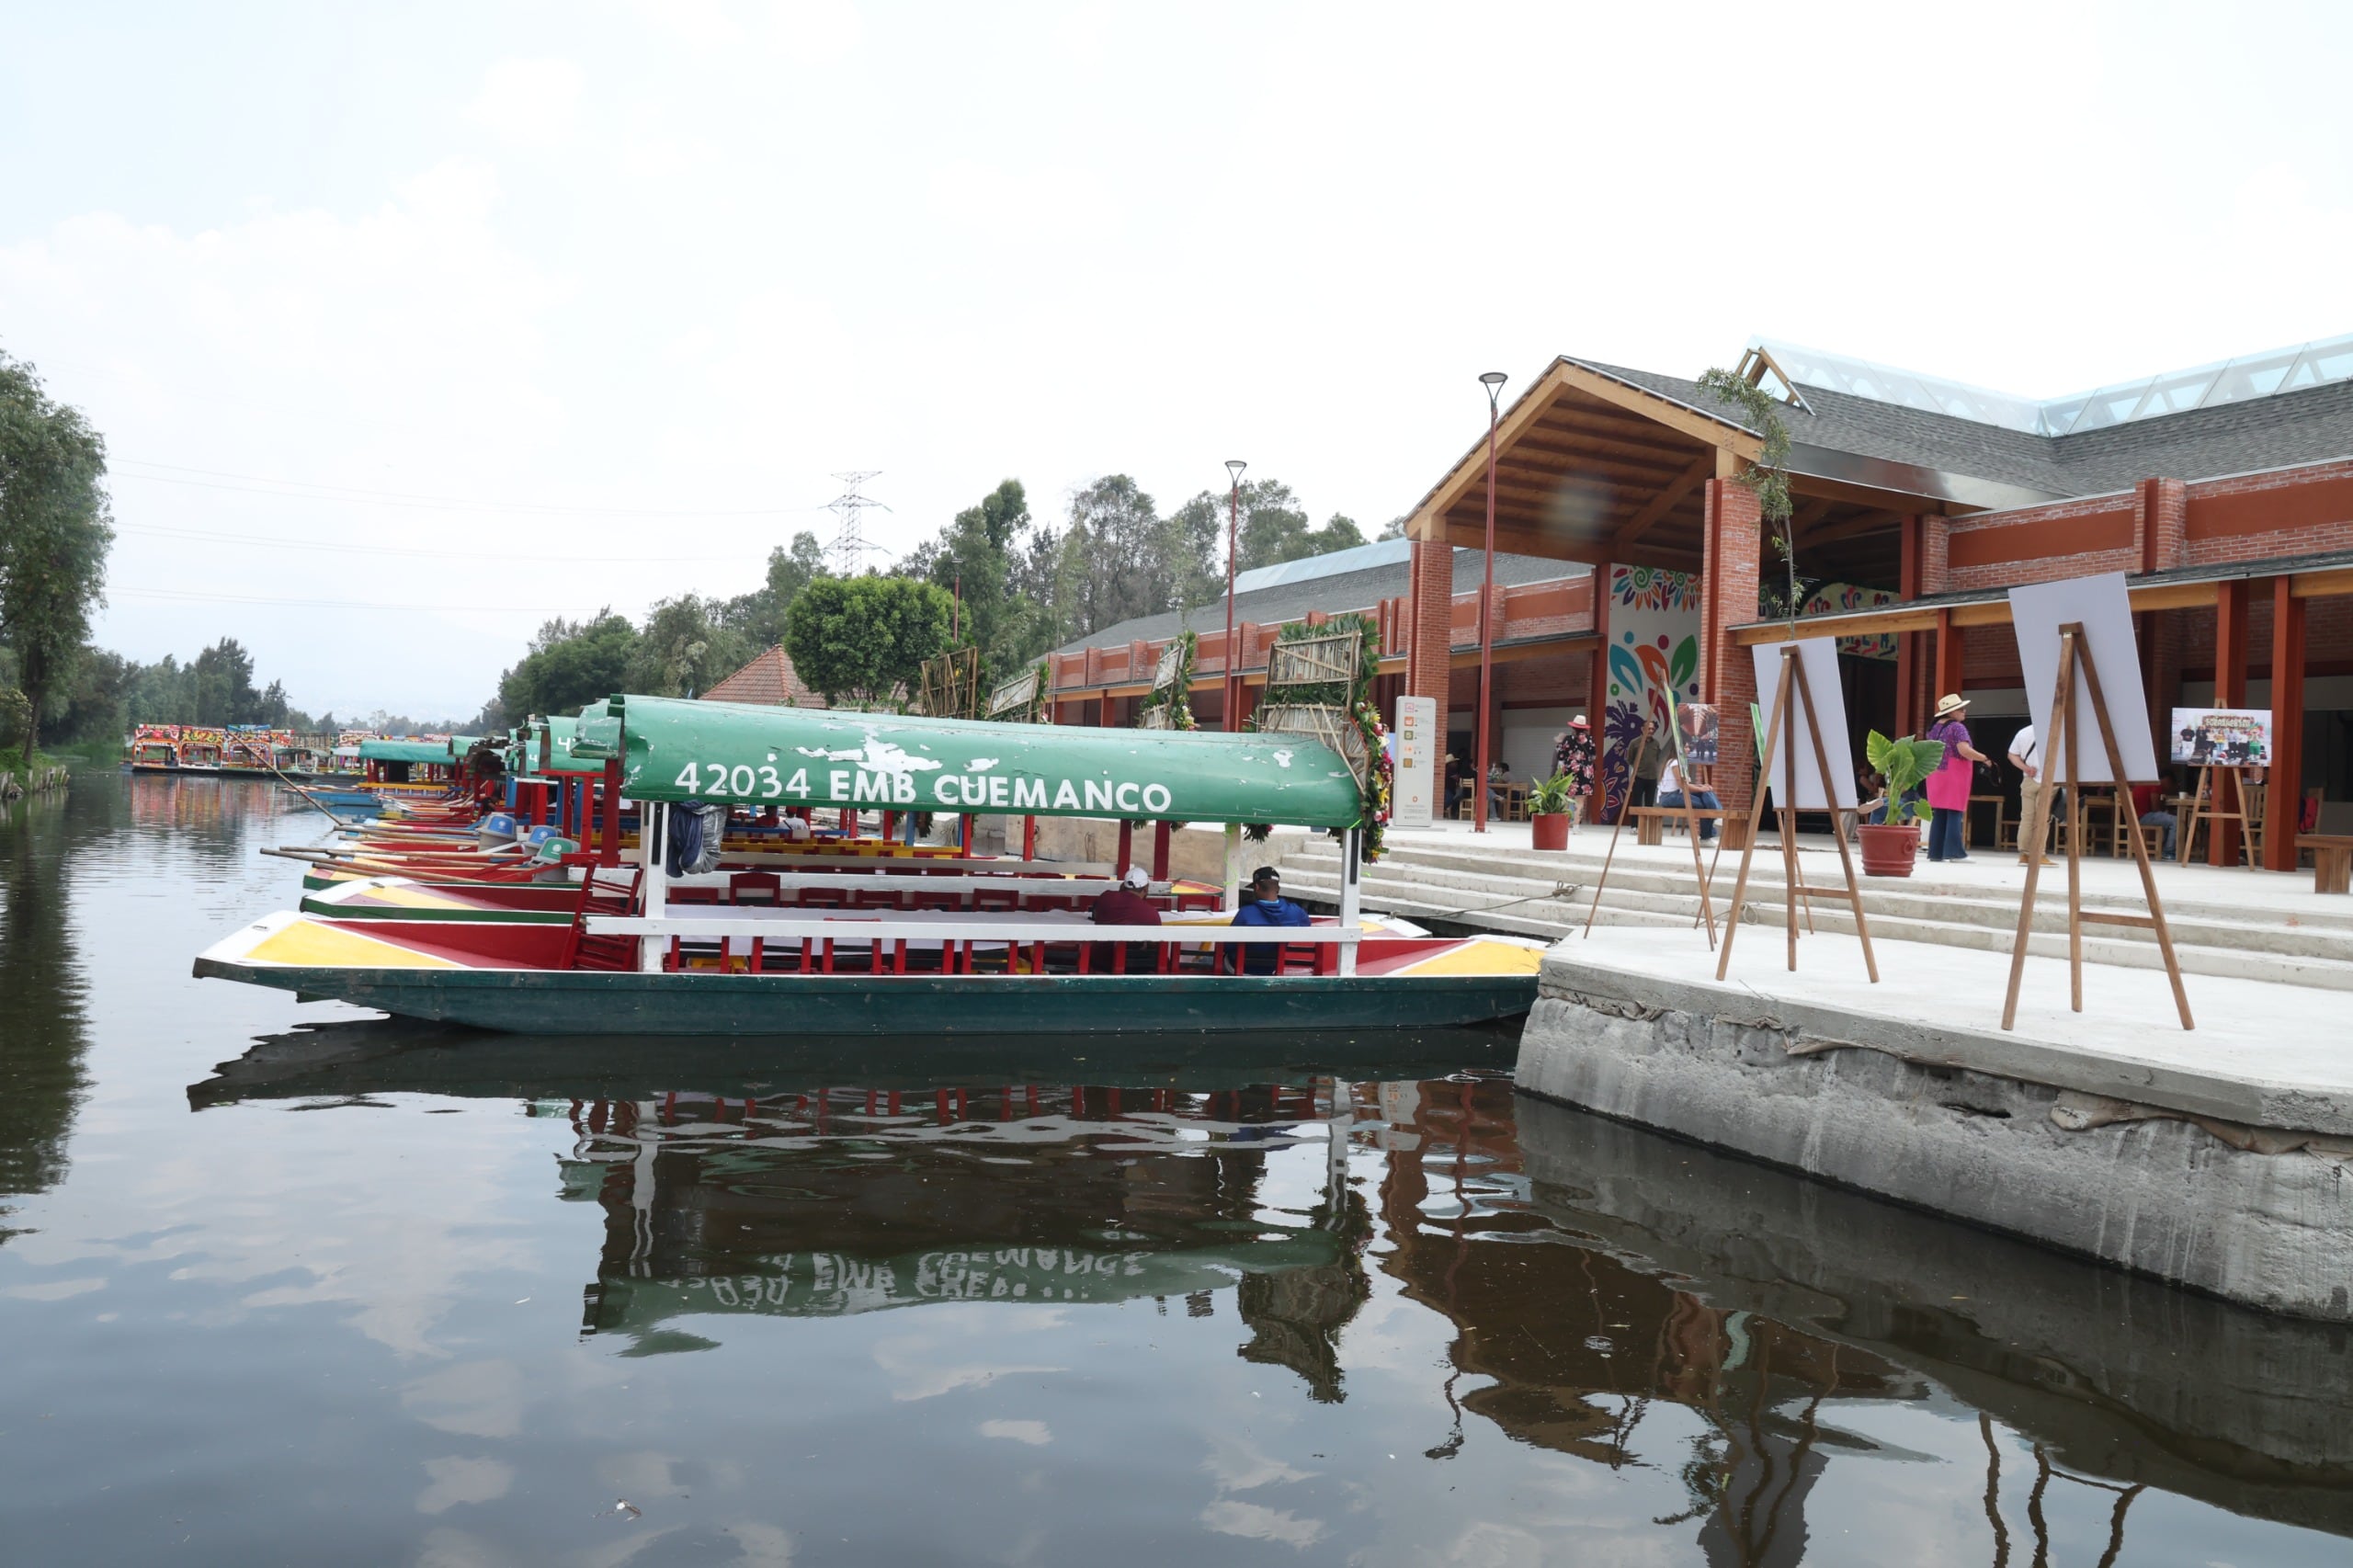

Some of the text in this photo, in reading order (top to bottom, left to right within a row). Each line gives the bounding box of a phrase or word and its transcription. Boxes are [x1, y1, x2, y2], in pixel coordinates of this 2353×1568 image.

[675, 761, 1172, 813] 42034 EMB CUEMANCO
